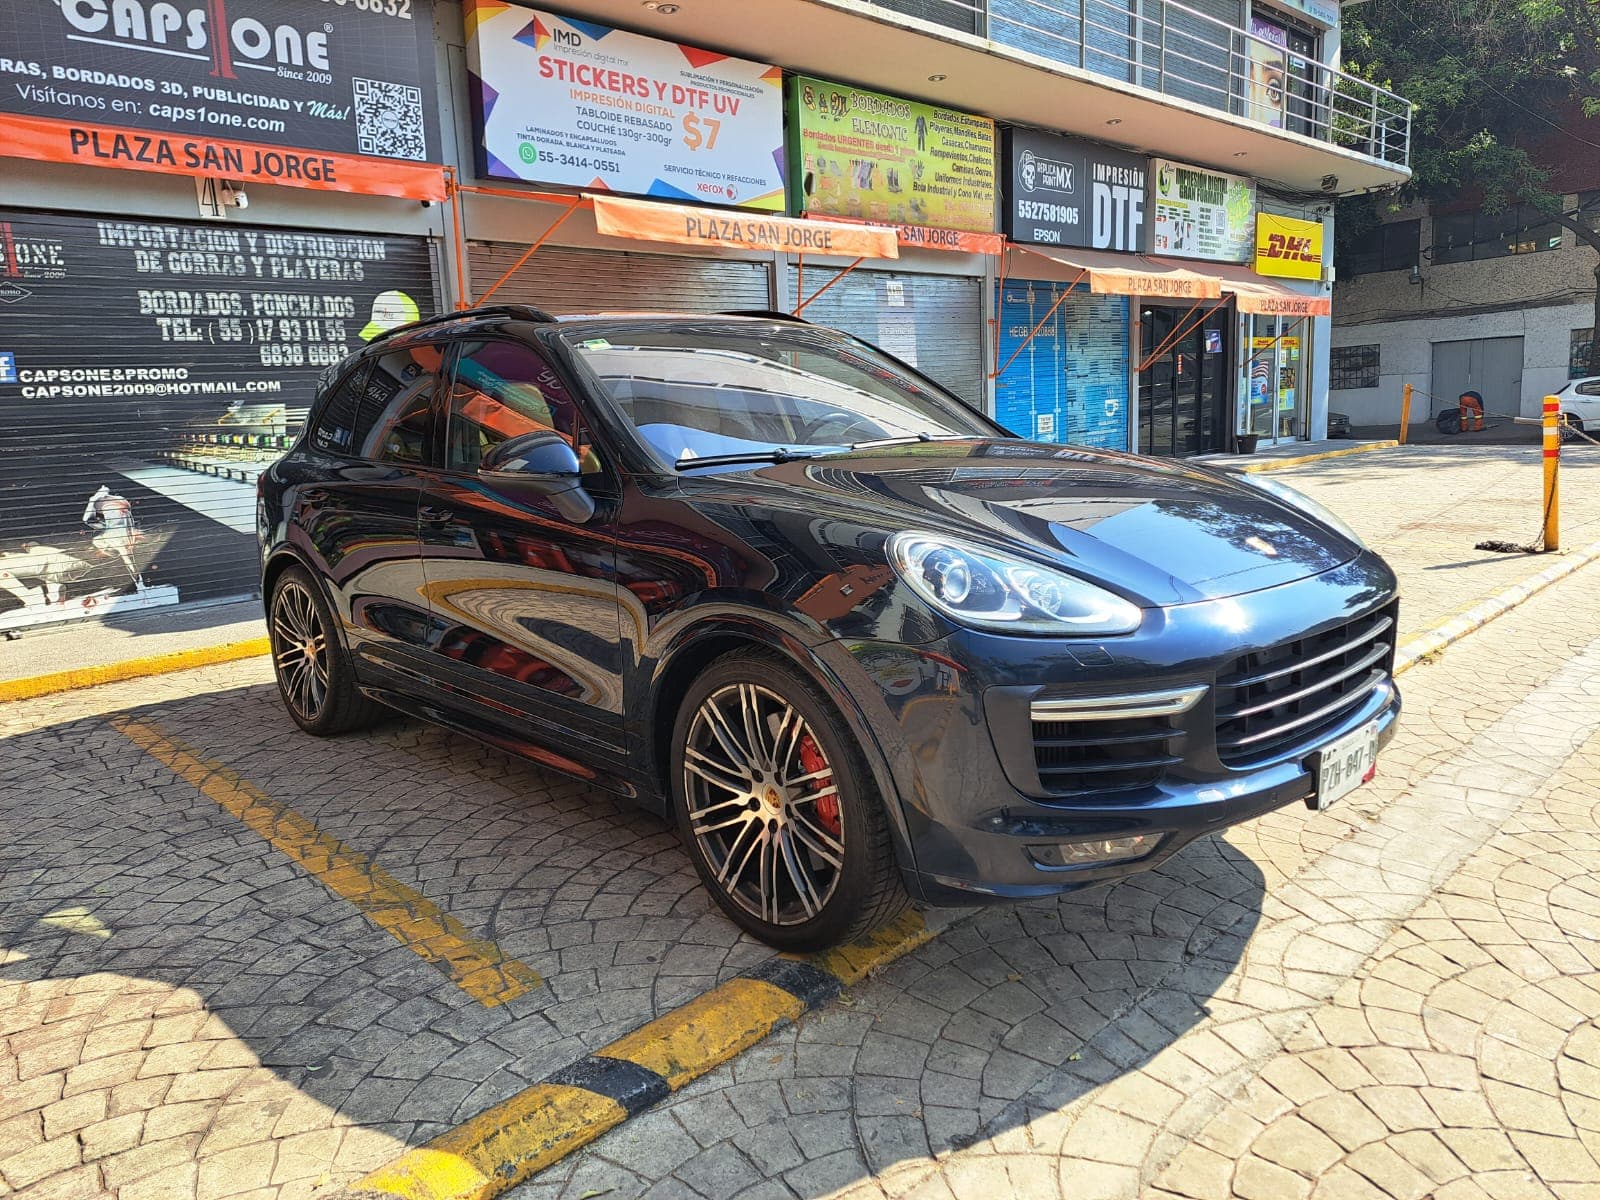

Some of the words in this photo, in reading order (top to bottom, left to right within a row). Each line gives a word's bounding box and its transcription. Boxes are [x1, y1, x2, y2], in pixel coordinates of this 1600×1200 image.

[553, 28, 582, 47] IMD
[277, 66, 303, 80] Since
[306, 70, 332, 84] 2009
[539, 56, 650, 98] STICKERS
[653, 80, 668, 101] Y
[672, 85, 709, 109] DTF
[713, 93, 741, 116] UV
[0, 58, 47, 79] RAS,
[52, 65, 156, 92] BORDADOS
[160, 81, 188, 98] 3D,
[193, 87, 290, 111] PUBLICIDAD
[293, 101, 304, 113] Y
[307, 100, 351, 120] Más!
[16, 82, 105, 110] Visítanos
[111, 98, 142, 115] en:
[149, 102, 285, 133] caps1one.com
[570, 88, 633, 110] IMPRESIÓN
[635, 102, 676, 119] DIGITAL
[575, 106, 622, 123] TABLOIDE
[624, 114, 673, 132] REBASADO
[682, 111, 721, 151] $7
[516, 132, 535, 141] TINTA
[566, 141, 590, 151] BLANCA
[525, 126, 564, 138] LAMINADOS
[576, 119, 616, 136] COUCHÉ
[618, 127, 673, 146] 130gr-300gr
[70, 128, 177, 166] PLAZA
[183, 142, 244, 173] SAN
[251, 150, 336, 183] JORGE
[538, 150, 621, 173] 55-3414-0551
[663, 164, 694, 175] SERVICIO
[726, 174, 767, 186] REFACCIONES
[1056, 166, 1072, 190] MX
[1092, 162, 1144, 187] IMPRESIÓN
[696, 182, 724, 194] xerox
[1018, 200, 1079, 225] 5527581905
[1092, 182, 1144, 251] DTF
[97, 222, 240, 252] IMPORTACION
[245, 232, 258, 252] Y
[264, 234, 387, 261] DISTRIBUCION
[686, 216, 743, 242] PLAZA
[747, 222, 780, 244] SAN
[784, 226, 833, 249] JORGE
[903, 226, 925, 242] SAN
[927, 229, 960, 246] JORGE
[1034, 228, 1060, 242] EPSON
[1267, 233, 1313, 262] DHL
[134, 250, 163, 273] DE
[168, 251, 246, 276] GORRAS
[252, 256, 264, 278] Y
[269, 257, 365, 282] PLAYERAS
[1128, 277, 1152, 291] PLAZA
[1154, 279, 1168, 293] SAN
[1170, 280, 1192, 293] JORGE
[250, 293, 355, 318] PONCHADOS
[1260, 299, 1278, 312] PLAZA
[1279, 300, 1291, 312] SAN
[1291, 301, 1308, 313] JORGE
[257, 319, 274, 342] 17
[279, 319, 300, 342] 93
[305, 319, 321, 342] 11
[325, 320, 347, 342] 55
[20, 368, 189, 383] CAPSONE&PROMO
[21, 381, 281, 399] CAPSONE2009@HOTMAIL.COM
